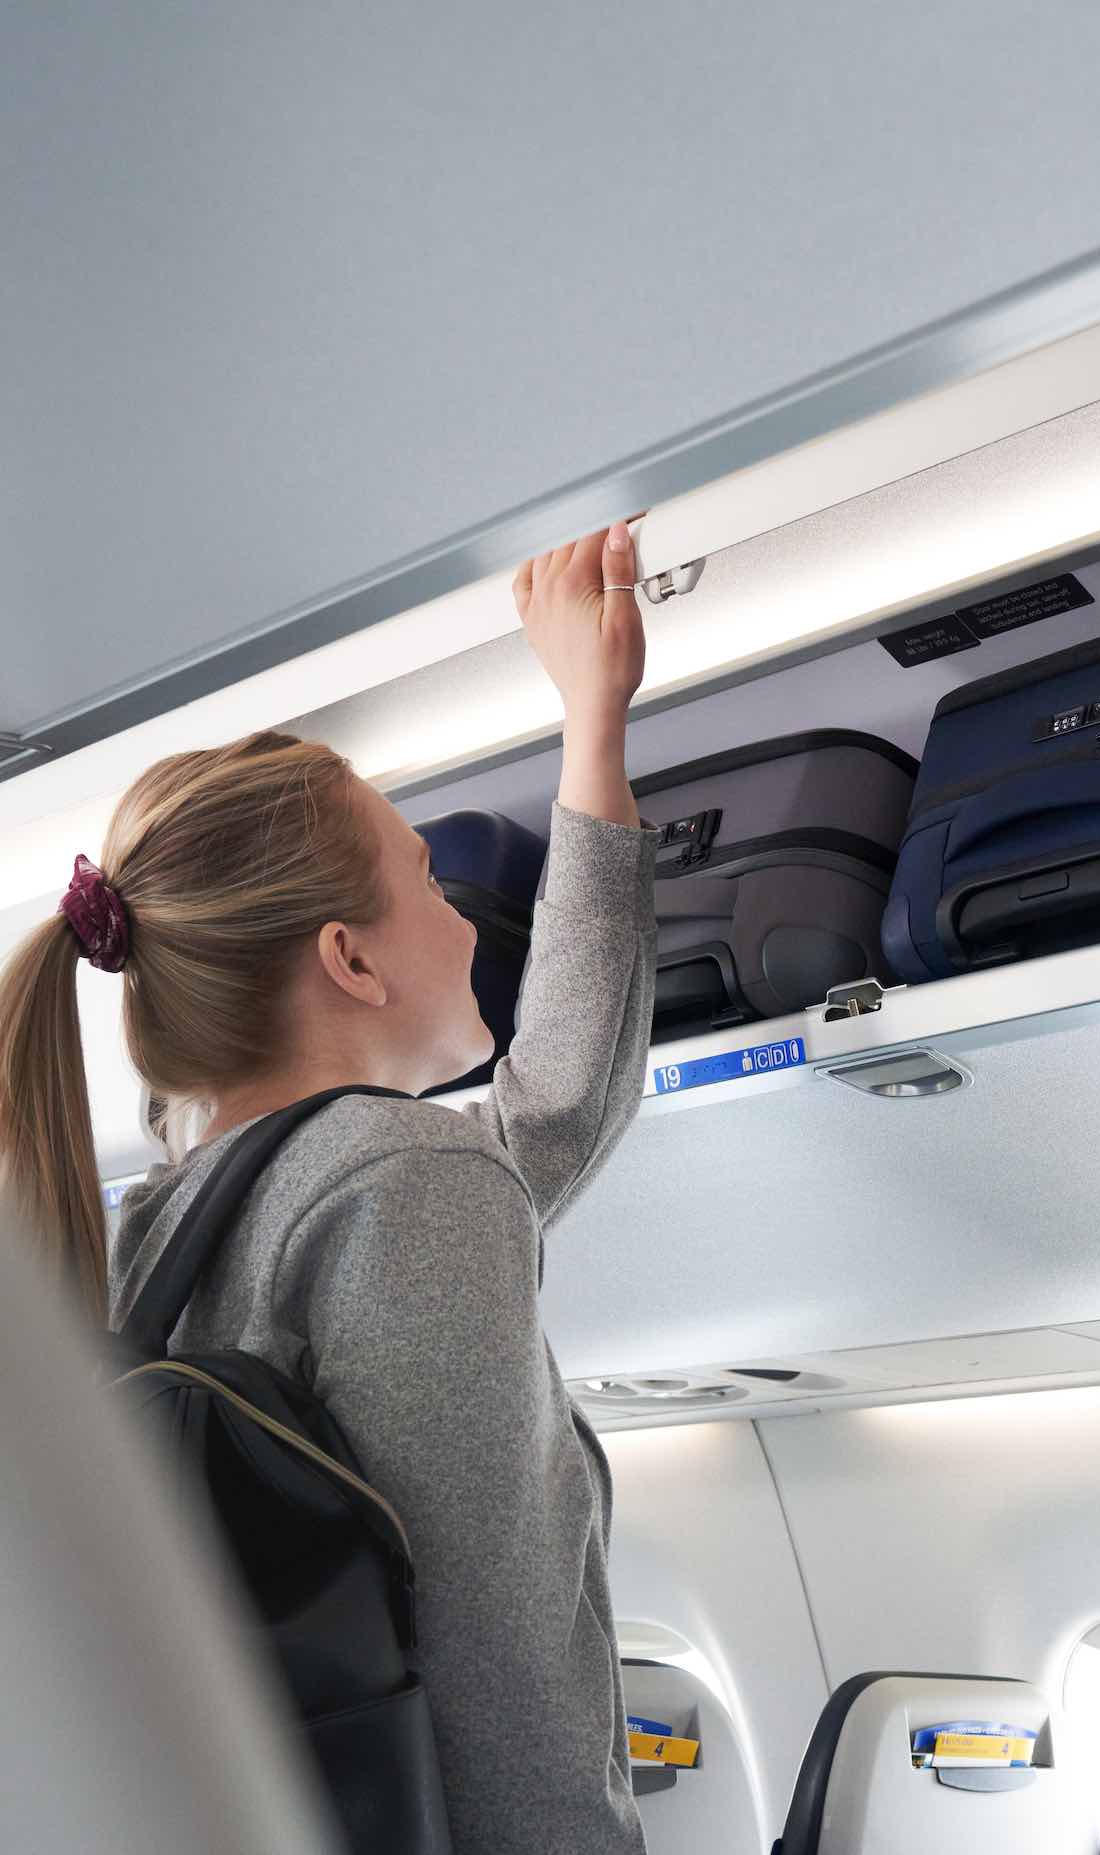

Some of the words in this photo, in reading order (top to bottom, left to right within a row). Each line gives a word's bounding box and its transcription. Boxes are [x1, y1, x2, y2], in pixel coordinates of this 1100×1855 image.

[660, 1065, 681, 1089] 19
[757, 1052, 769, 1068] C
[774, 1049, 785, 1065] D
